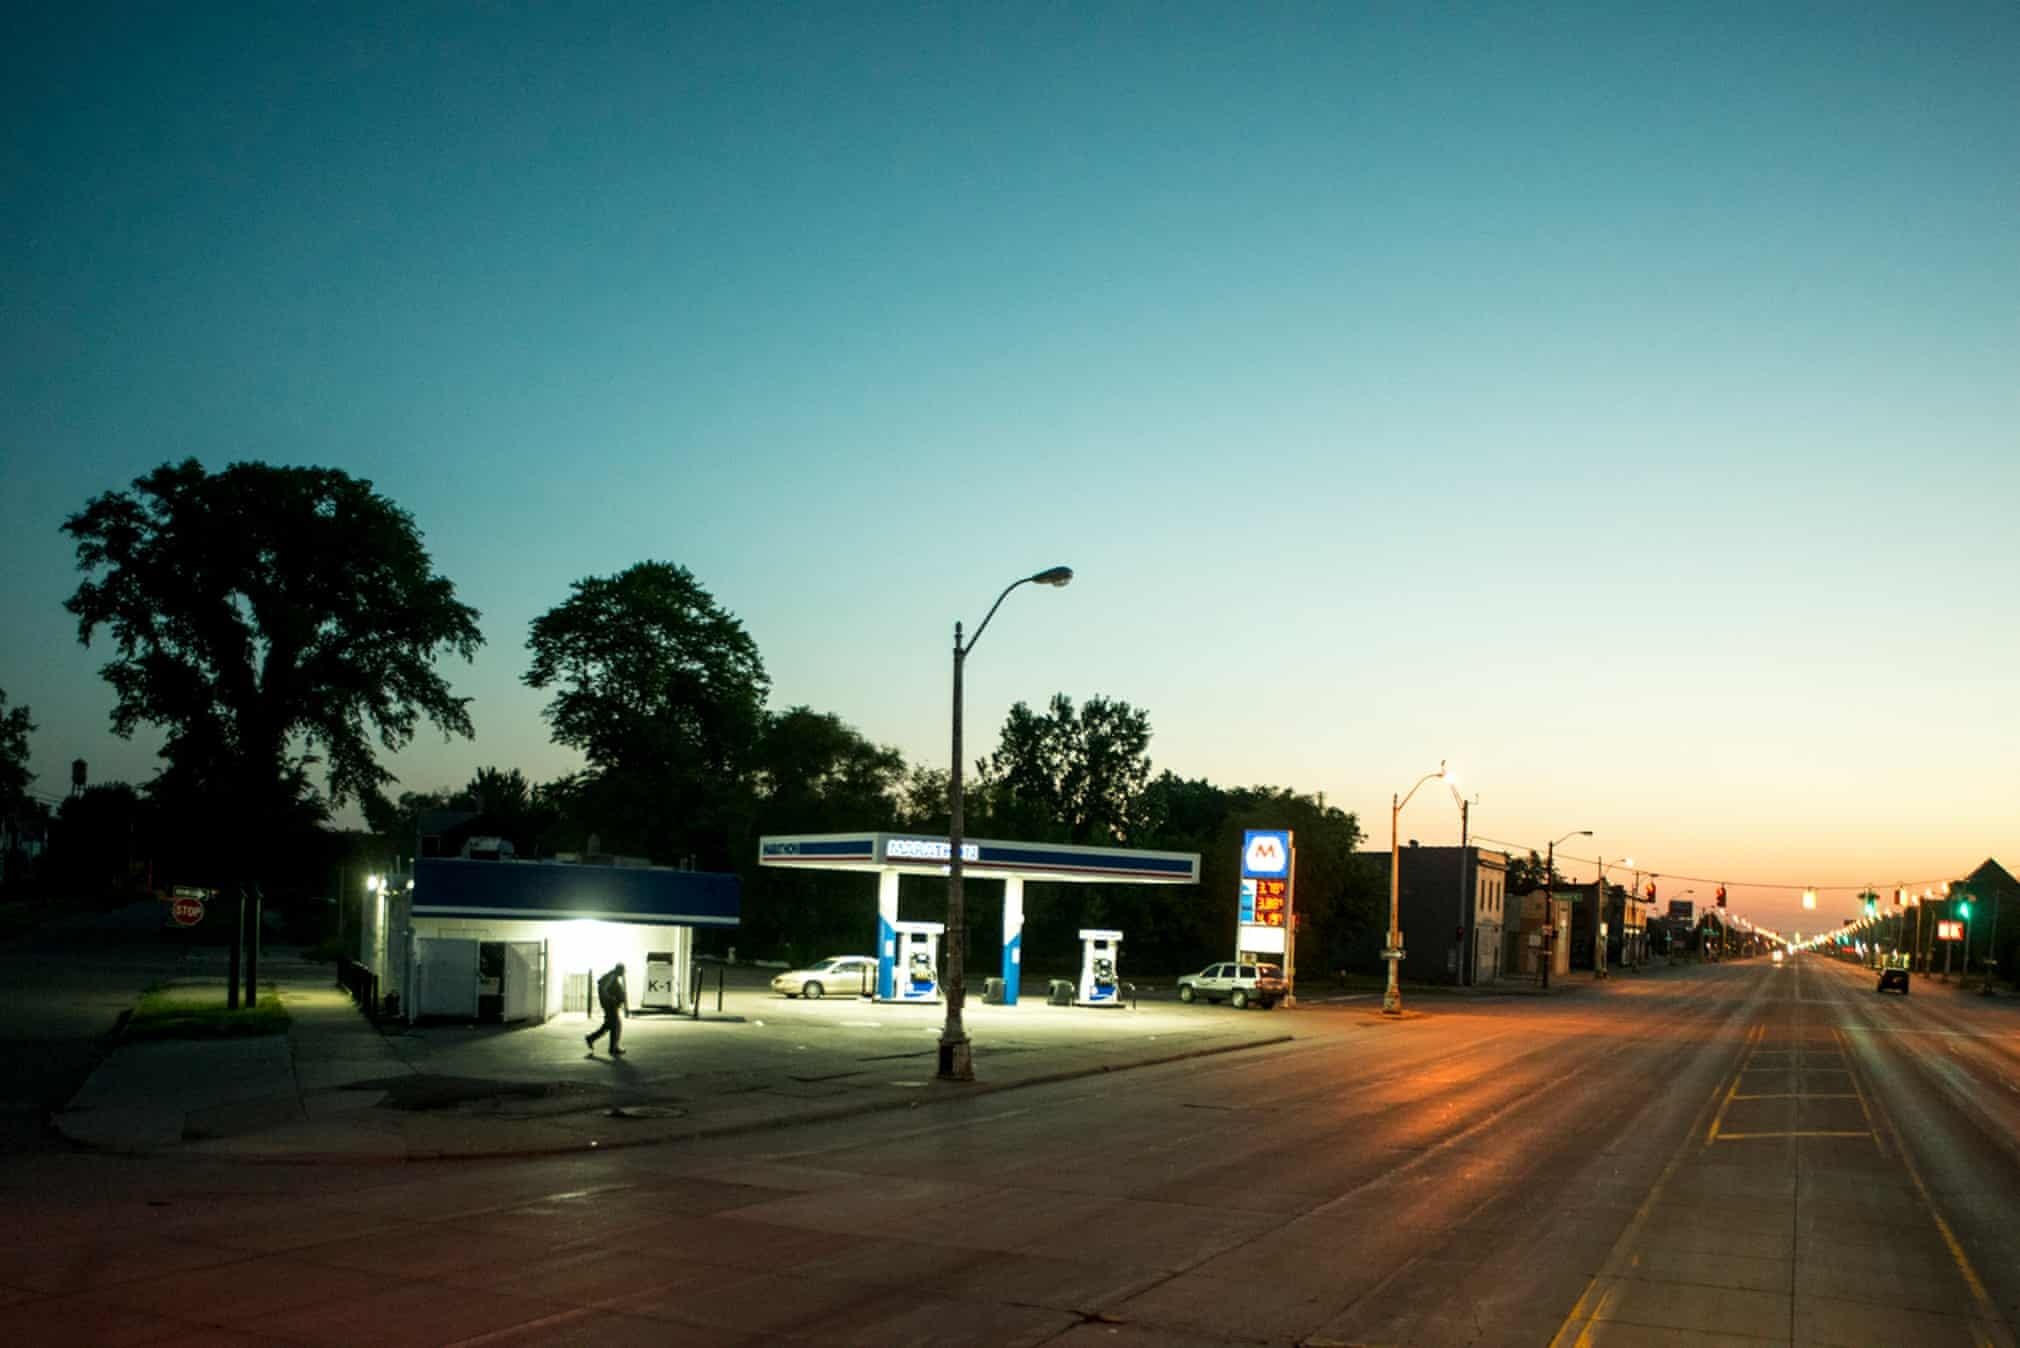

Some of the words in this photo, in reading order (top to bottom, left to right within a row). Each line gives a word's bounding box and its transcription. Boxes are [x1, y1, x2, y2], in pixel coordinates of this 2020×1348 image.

[1255, 844, 1276, 858] M
[176, 903, 201, 917] STOP
[647, 978, 672, 993] K-1
